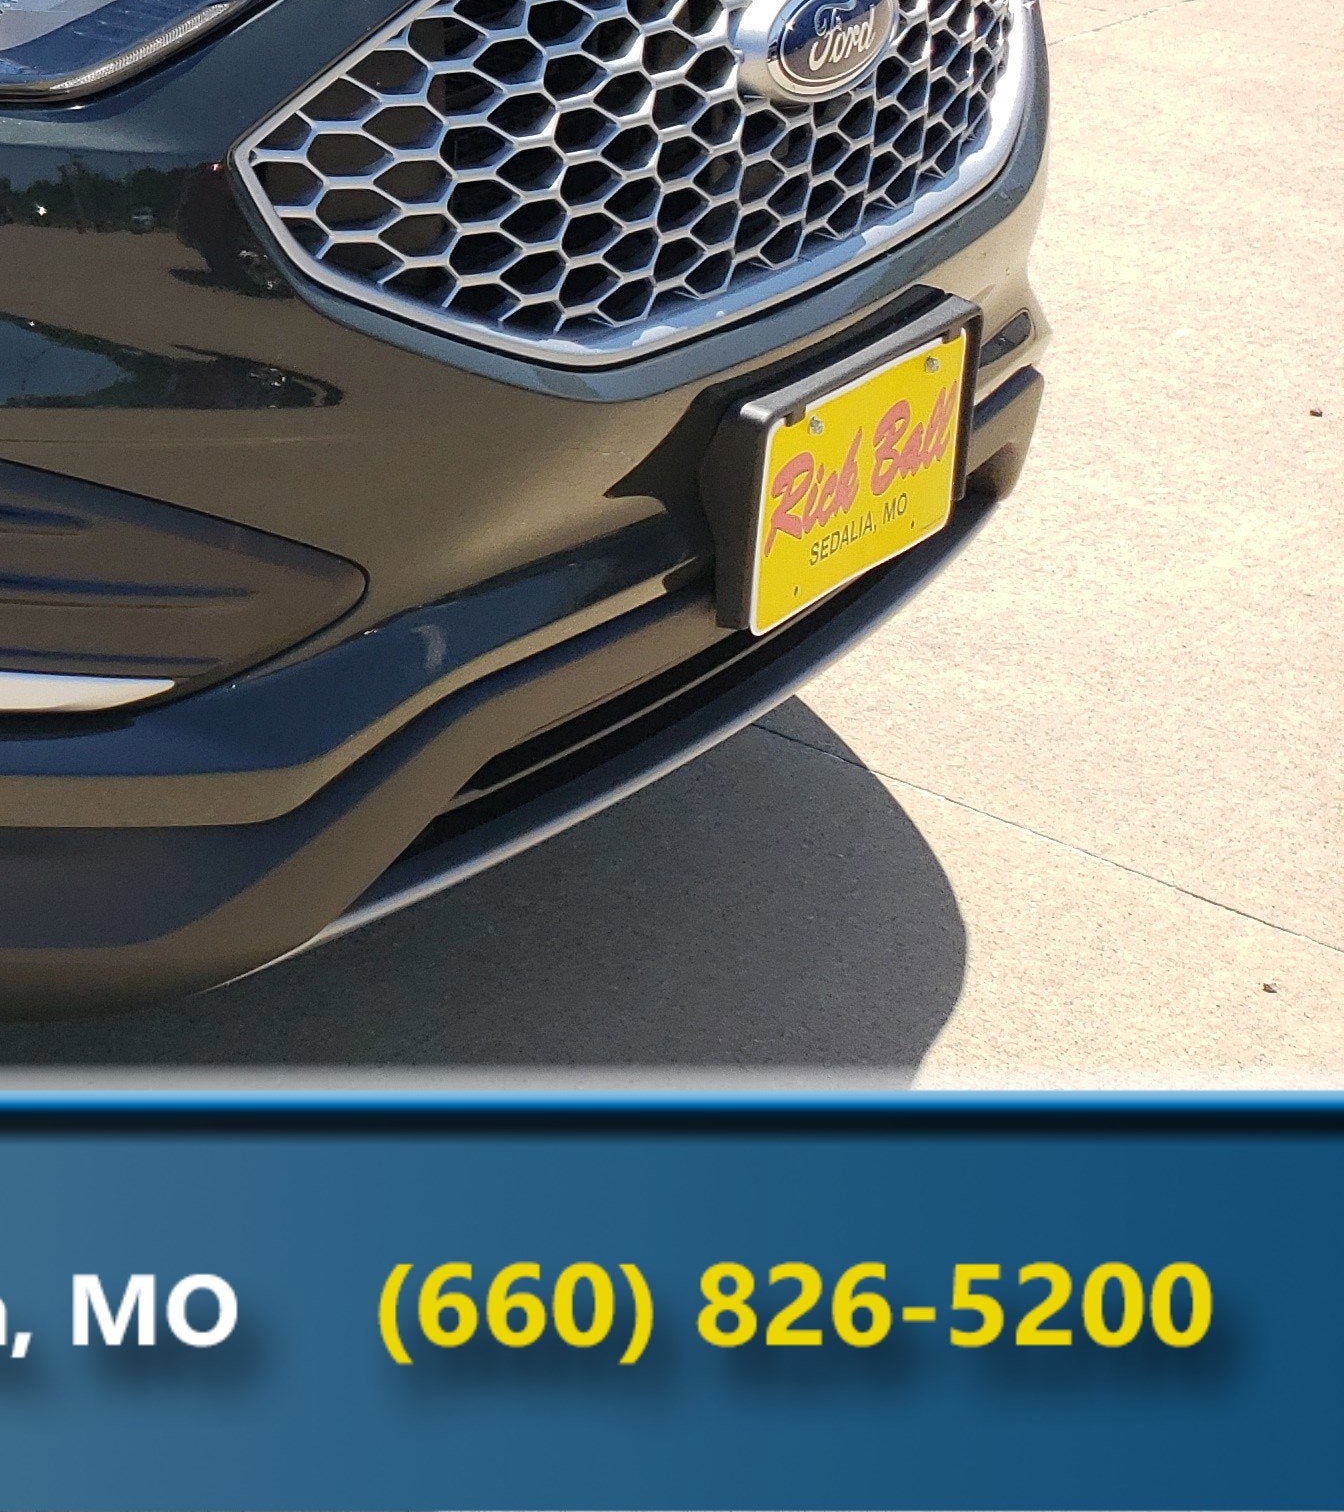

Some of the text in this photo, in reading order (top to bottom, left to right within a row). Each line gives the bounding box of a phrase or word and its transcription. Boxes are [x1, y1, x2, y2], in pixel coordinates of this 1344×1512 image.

[764, 380, 960, 558] Rick Ball
[809, 492, 909, 567] SEDALIA, MO
